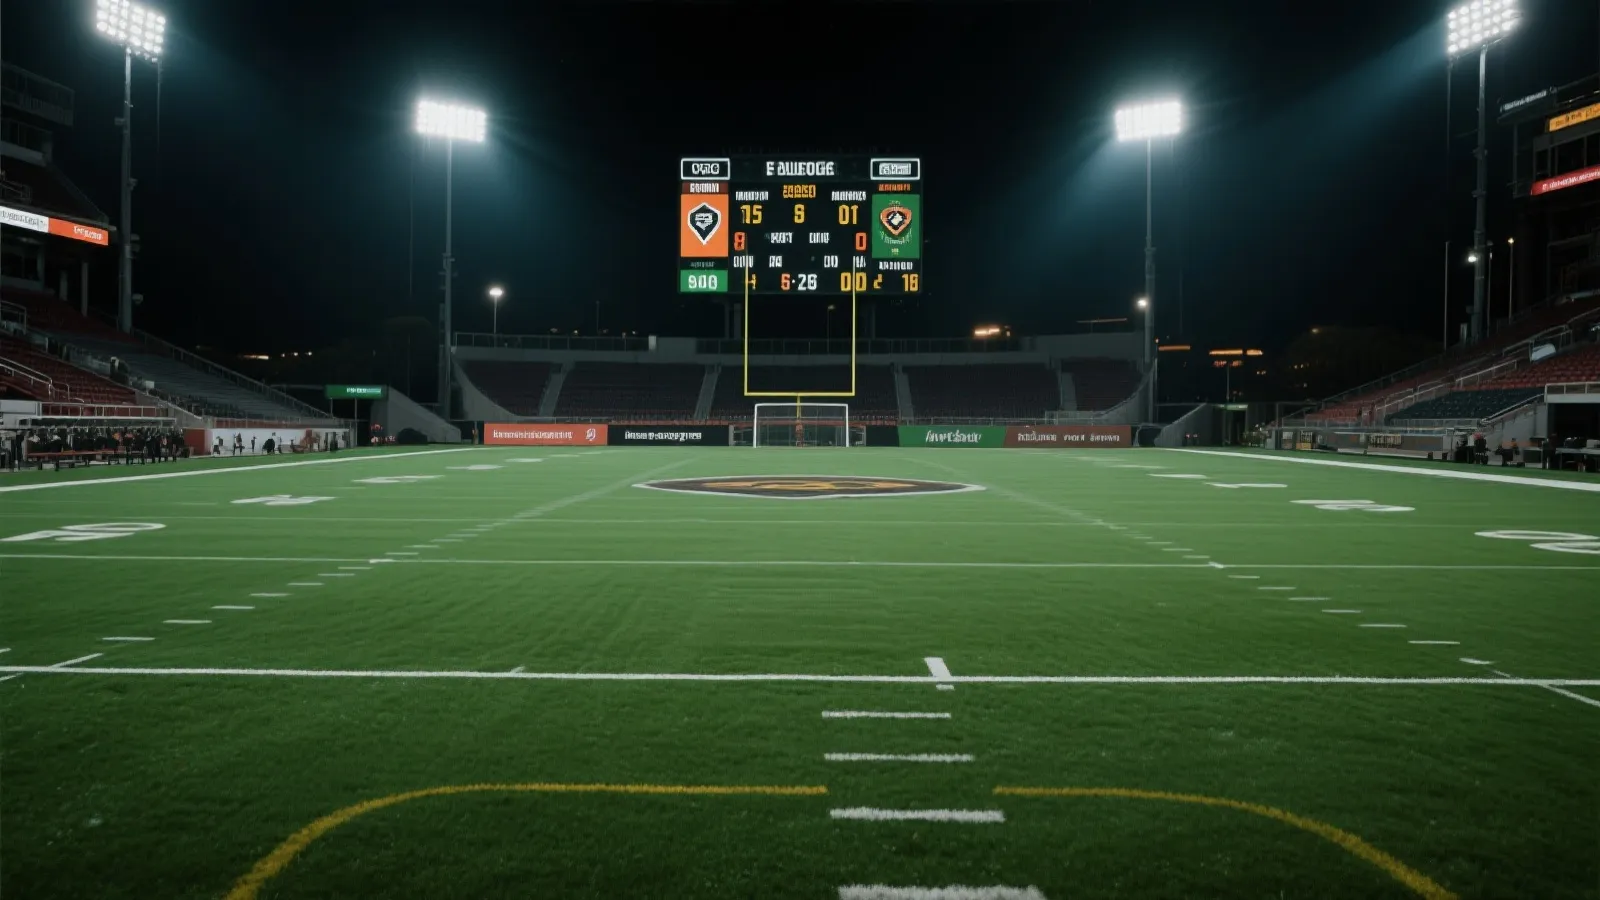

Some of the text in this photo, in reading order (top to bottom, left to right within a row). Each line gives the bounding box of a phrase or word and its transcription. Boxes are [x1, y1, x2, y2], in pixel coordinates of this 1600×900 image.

[741, 204, 763, 224] 15
[838, 204, 859, 225] 01
[855, 232, 867, 251] 0
